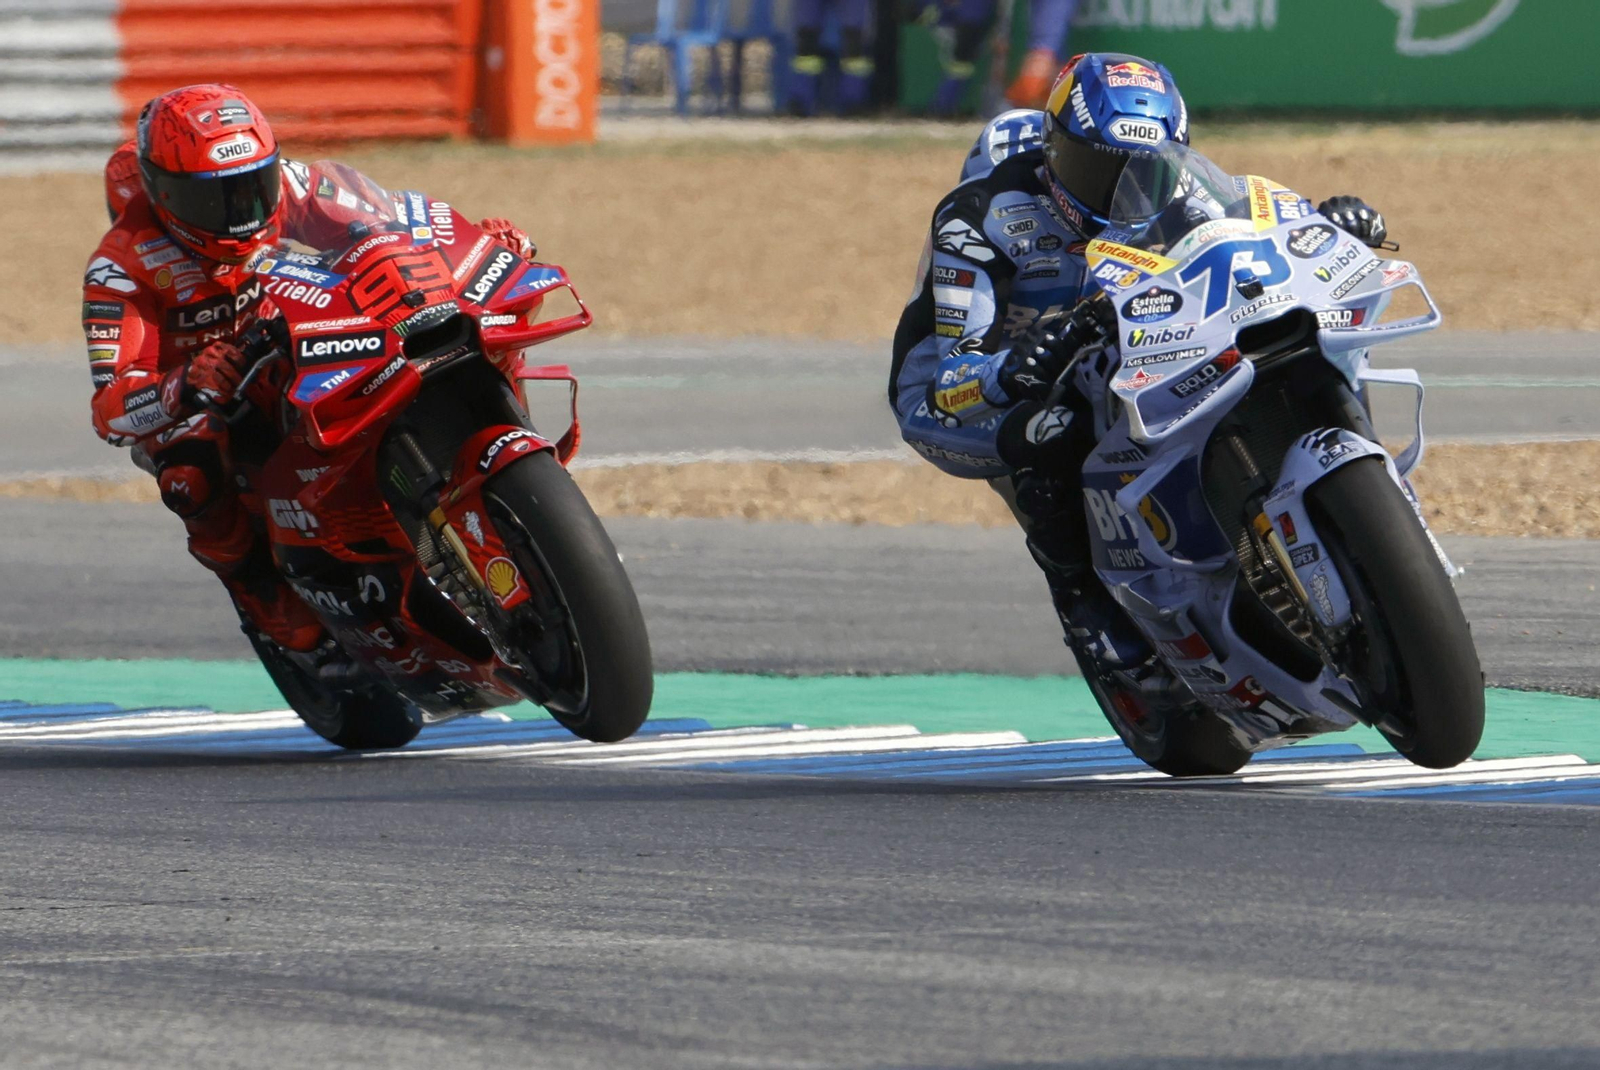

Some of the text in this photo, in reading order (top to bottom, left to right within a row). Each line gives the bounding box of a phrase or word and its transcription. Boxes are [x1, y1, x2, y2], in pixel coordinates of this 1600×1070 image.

[1108, 75, 1165, 94] Red Bull
[1119, 123, 1158, 141] SHOEI
[217, 142, 253, 159] SHOEI
[1275, 192, 1301, 220] BK8
[429, 202, 453, 236] riello
[1007, 220, 1033, 235] SHOEI
[453, 236, 490, 280] FRECCIAROSSA
[1095, 242, 1159, 270] Antangin
[1313, 244, 1362, 283] Unibat
[275, 265, 330, 284] ADVANCE
[465, 252, 513, 302] Lenovo
[529, 277, 560, 290] TIM
[1097, 263, 1141, 286] BK8
[1177, 237, 1293, 323] 73
[274, 281, 332, 308] riello
[1131, 293, 1175, 309] Estrella
[406, 302, 458, 325] MONSTER
[1131, 303, 1172, 316] Galicia
[1230, 293, 1296, 325] Gigetta
[1316, 310, 1352, 324] BOLD
[295, 316, 371, 331] FRECCIAROSSA
[302, 337, 381, 357] Lenovo
[1127, 326, 1195, 348] Unibat
[1127, 358, 1143, 368] MS
[1144, 353, 1176, 365] GLOW
[321, 370, 350, 390] TIM
[363, 356, 406, 395] CARRERA
[1175, 364, 1217, 393] BOLD
[130, 407, 163, 428] Unipol
[1107, 548, 1145, 567] NEWS
